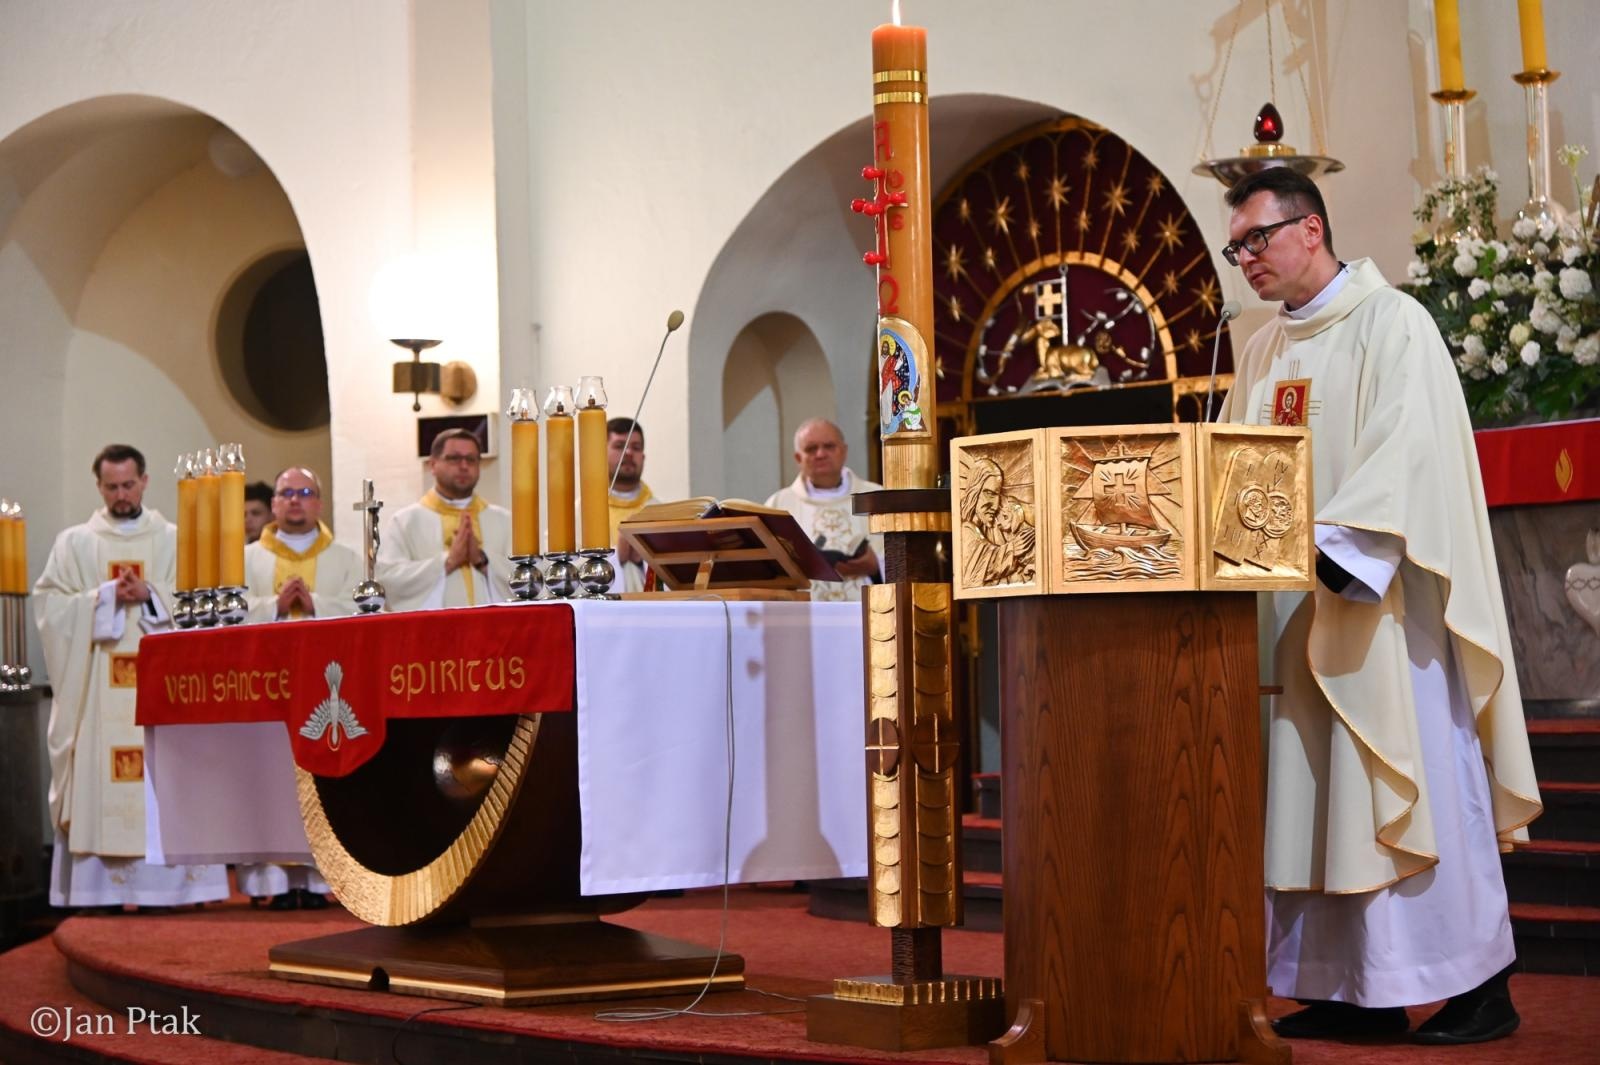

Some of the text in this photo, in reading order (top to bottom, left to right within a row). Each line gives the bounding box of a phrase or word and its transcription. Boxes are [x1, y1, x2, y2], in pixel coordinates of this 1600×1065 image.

[164, 655, 526, 704] VENI SANCTE SPIRITUS
